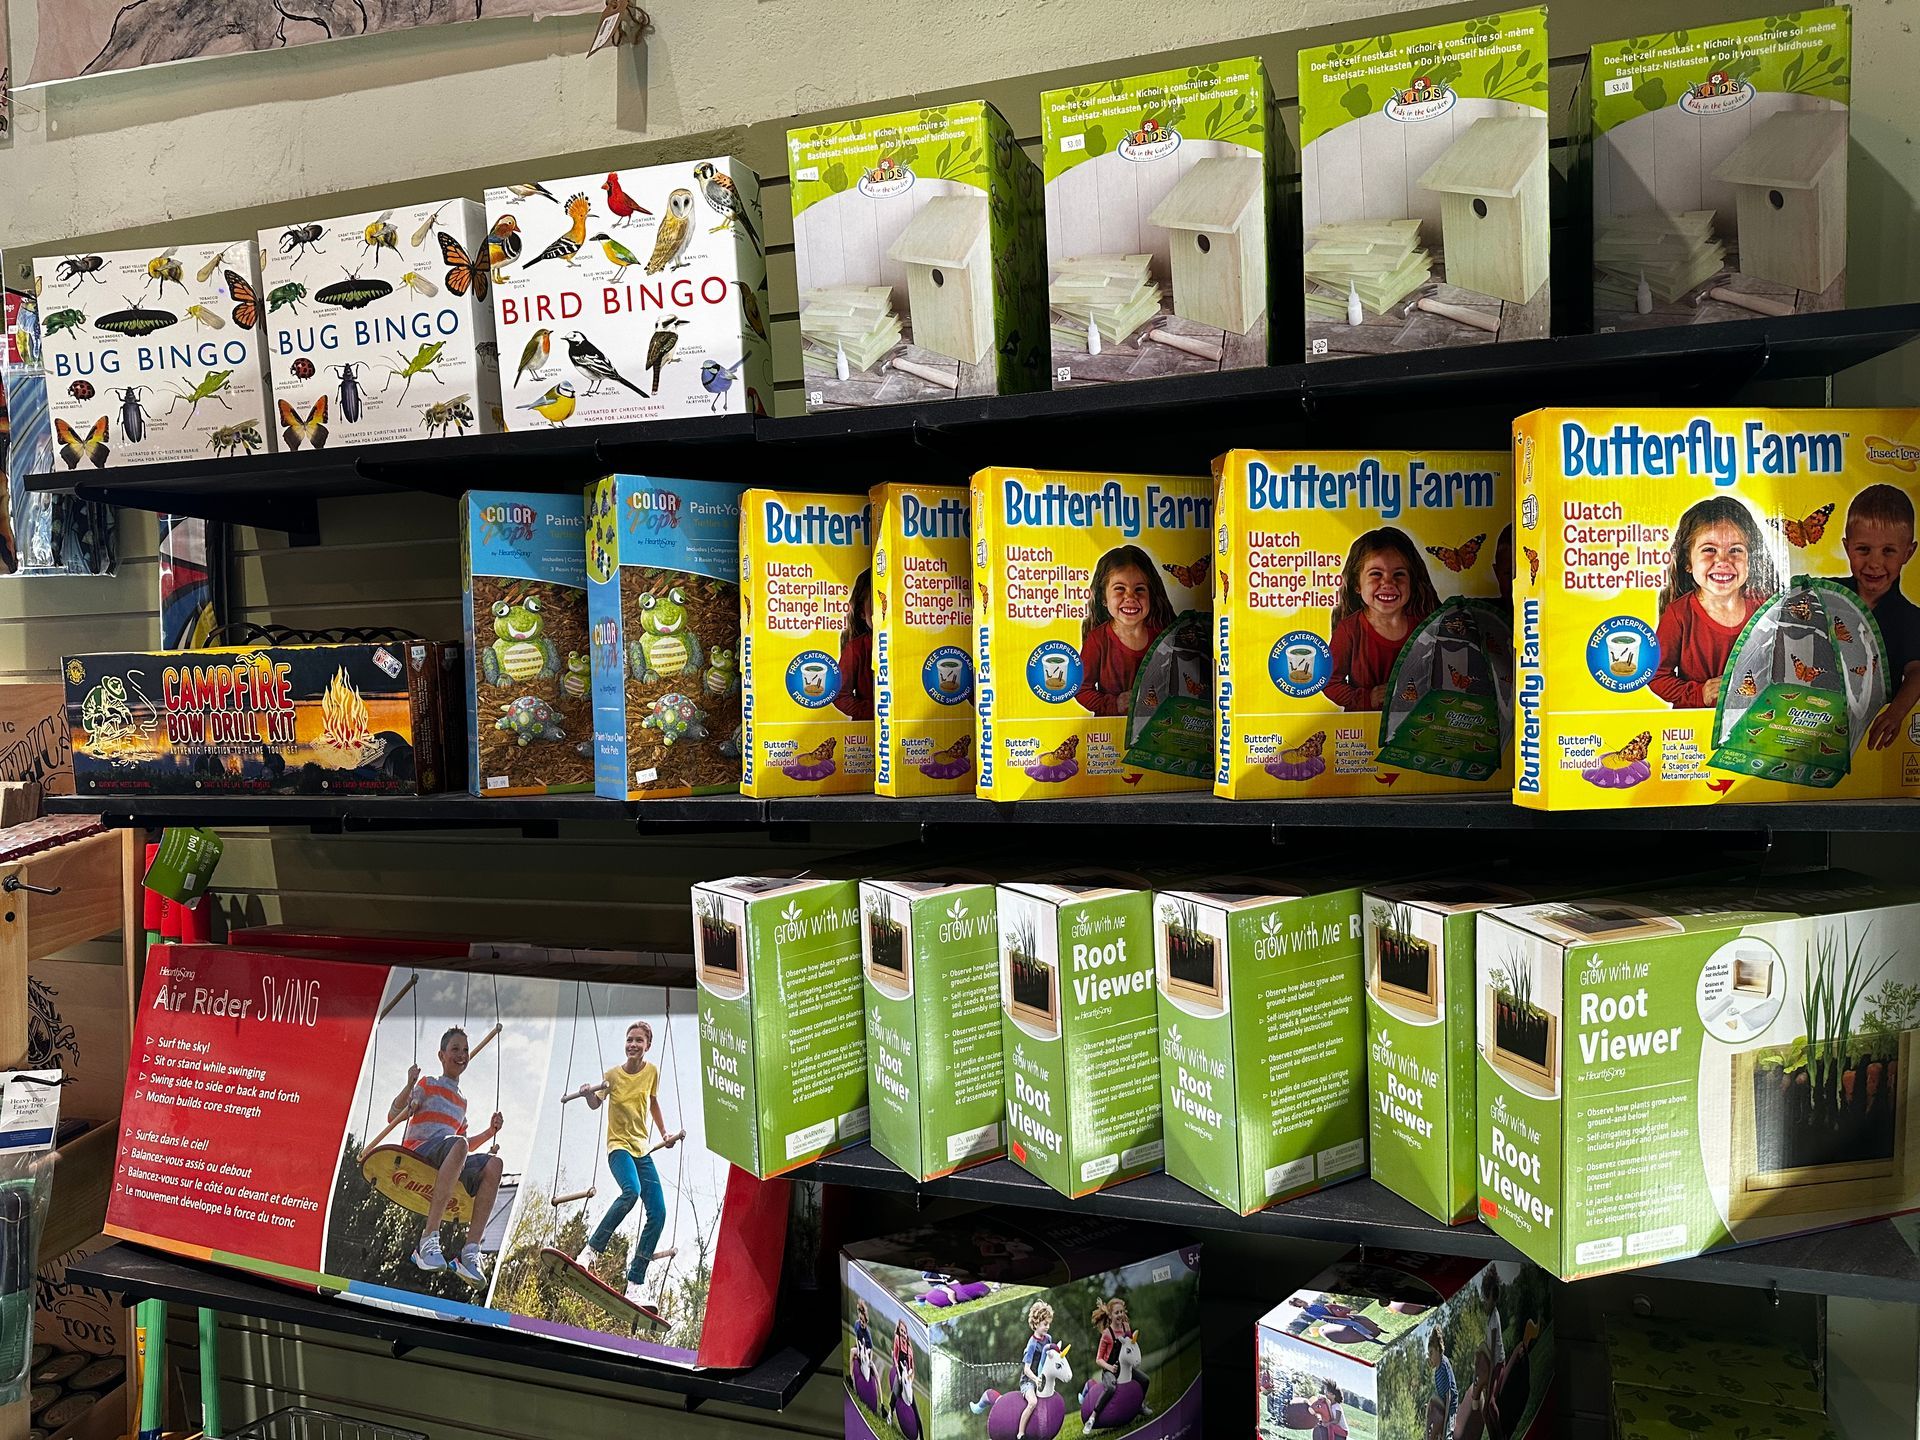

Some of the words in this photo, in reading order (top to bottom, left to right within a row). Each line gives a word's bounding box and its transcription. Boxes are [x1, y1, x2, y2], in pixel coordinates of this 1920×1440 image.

[1311, 57, 1360, 71] Doe-het-zelf
[1362, 50, 1397, 62] nestkast
[1406, 43, 1436, 55] Nichoir
[1438, 41, 1443, 49] à
[1445, 35, 1488, 48] construire
[1489, 33, 1502, 42] soi
[1604, 52, 1655, 65] Doe-het-zelf
[1657, 45, 1694, 57] nestkast
[1703, 38, 1734, 50] Nichoir
[1743, 30, 1788, 43] construire
[1790, 28, 1803, 37] soi
[1322, 61, 1412, 83] Bastelsatz-Nistkasten
[1421, 57, 1432, 66] Do
[1434, 56, 1440, 64] it
[1442, 50, 1477, 65] yourself
[1479, 43, 1521, 56] birdhouse
[1399, 89, 1441, 104] KIDS
[1697, 82, 1739, 99] KIDS
[1392, 107, 1405, 116] Kids
[1426, 100, 1448, 113] Garden
[1132, 131, 1168, 146] KIDS
[870, 168, 903, 184] KIDS
[502, 292, 582, 325] BIRD
[603, 277, 727, 315] BINGO
[279, 325, 339, 355] BUG
[355, 309, 459, 346] BINGO
[56, 350, 120, 377] BUG
[138, 341, 247, 371] BINGO
[576, 408, 610, 416] ILLUSTRATED
[619, 405, 645, 413] CHRISTINE
[1562, 419, 1737, 486] Butterfly
[632, 492, 676, 510] COLOR
[1248, 459, 1400, 518] Butterfly
[486, 507, 532, 523] COLOR
[1004, 480, 1140, 537] Butterfly
[1564, 501, 1622, 521] Watch
[1249, 532, 1300, 548] Watch
[1564, 524, 1669, 548] Caterpillars
[498, 549, 532, 558] HearthSong
[1249, 552, 1341, 571] Caterpillars
[1564, 548, 1630, 569] Change
[1636, 547, 1671, 565] Into
[768, 562, 813, 578] Watch
[1249, 572, 1307, 591] Change
[1312, 571, 1343, 587] Into
[1564, 571, 1667, 590] Butterflies!
[768, 580, 848, 599] Caterpillars
[1249, 592, 1339, 608] Butterflies!
[768, 598, 818, 617] Change
[824, 599, 850, 612] Into
[768, 616, 847, 629] Butterflies!
[1591, 624, 1610, 648] FREE
[1611, 619, 1656, 647] CATERPILLARS
[878, 633, 888, 685] Farm
[978, 627, 989, 684] Farm
[1218, 617, 1229, 675] Farm
[744, 636, 752, 688] Farm
[163, 662, 294, 712] CAMPFIRE
[1596, 670, 1617, 690] FREE
[1618, 668, 1653, 690] SHIPPING!
[165, 711, 205, 743] BOW
[211, 711, 260, 743] DRILL
[267, 711, 296, 742] KIT
[744, 694, 754, 785] Butterfly
[878, 691, 891, 784] Butterfly
[980, 689, 994, 788] Butterfly
[1218, 681, 1233, 785] Butterfly
[1519, 676, 1543, 792] Butterfly
[1559, 735, 1601, 747] Butterfly
[1663, 729, 1693, 740] NEW!
[170, 746, 200, 754] AUTHENTIC
[268, 746, 284, 754] TOOL
[1565, 748, 1595, 756] Feeder
[1662, 743, 1676, 751] Tuck
[1680, 743, 1698, 752] Away
[1662, 752, 1679, 760] Panel
[1682, 752, 1706, 760] Teaches
[1560, 758, 1600, 769] Included!
[1662, 772, 1711, 780] Metamorphosis!
[1669, 762, 1690, 770] Stages
[187, 835, 199, 852] Tool
[1073, 938, 1126, 972] Root
[160, 967, 195, 981] HearthSong
[1073, 968, 1154, 1005] Viewer
[153, 985, 187, 1011] Air
[192, 987, 252, 1019] Rider
[1581, 988, 1649, 1025] Root
[158, 1037, 176, 1048] Surf
[177, 1039, 191, 1051] the
[193, 1041, 210, 1053] sky!
[1579, 1027, 1682, 1065] Viewer
[154, 1055, 166, 1065] Sit
[167, 1058, 176, 1067] or
[178, 1059, 201, 1070] stand
[203, 1062, 227, 1074] while
[228, 1066, 266, 1081] swinging
[712, 1047, 738, 1076] Root
[879, 1045, 903, 1077] Root
[1586, 1068, 1626, 1082] HearthSong
[150, 1073, 174, 1087] Swing
[175, 1077, 192, 1088] side
[195, 1080, 204, 1089] to
[205, 1079, 223, 1091] side
[225, 1084, 235, 1093] or
[237, 1084, 257, 1097] back
[259, 1087, 276, 1100] and
[278, 1089, 300, 1103] forth
[707, 1066, 745, 1100] Viewer
[874, 1064, 910, 1103] Viewer
[1014, 1072, 1051, 1116] Root
[1178, 1067, 1212, 1102] Root
[1388, 1073, 1423, 1110] Root
[1171, 1086, 1222, 1129] Viewer
[1378, 1091, 1433, 1139] Viewer
[1587, 1104, 1614, 1117] Observe
[1615, 1103, 1629, 1114] how
[1630, 1101, 1651, 1112] plants
[1651, 1098, 1667, 1109] grow
[1669, 1094, 1687, 1104] above
[1588, 1115, 1627, 1129] ground-and
[1628, 1111, 1649, 1121] below!
[136, 1129, 159, 1143] Surfez
[160, 1133, 179, 1146] dans
[181, 1137, 189, 1147] le
[190, 1138, 209, 1150] ciel!
[1008, 1099, 1062, 1154] Viewer
[1492, 1126, 1540, 1184] Root
[1479, 1153, 1553, 1228] Viewer
[56, 1315, 116, 1345] TOYS
